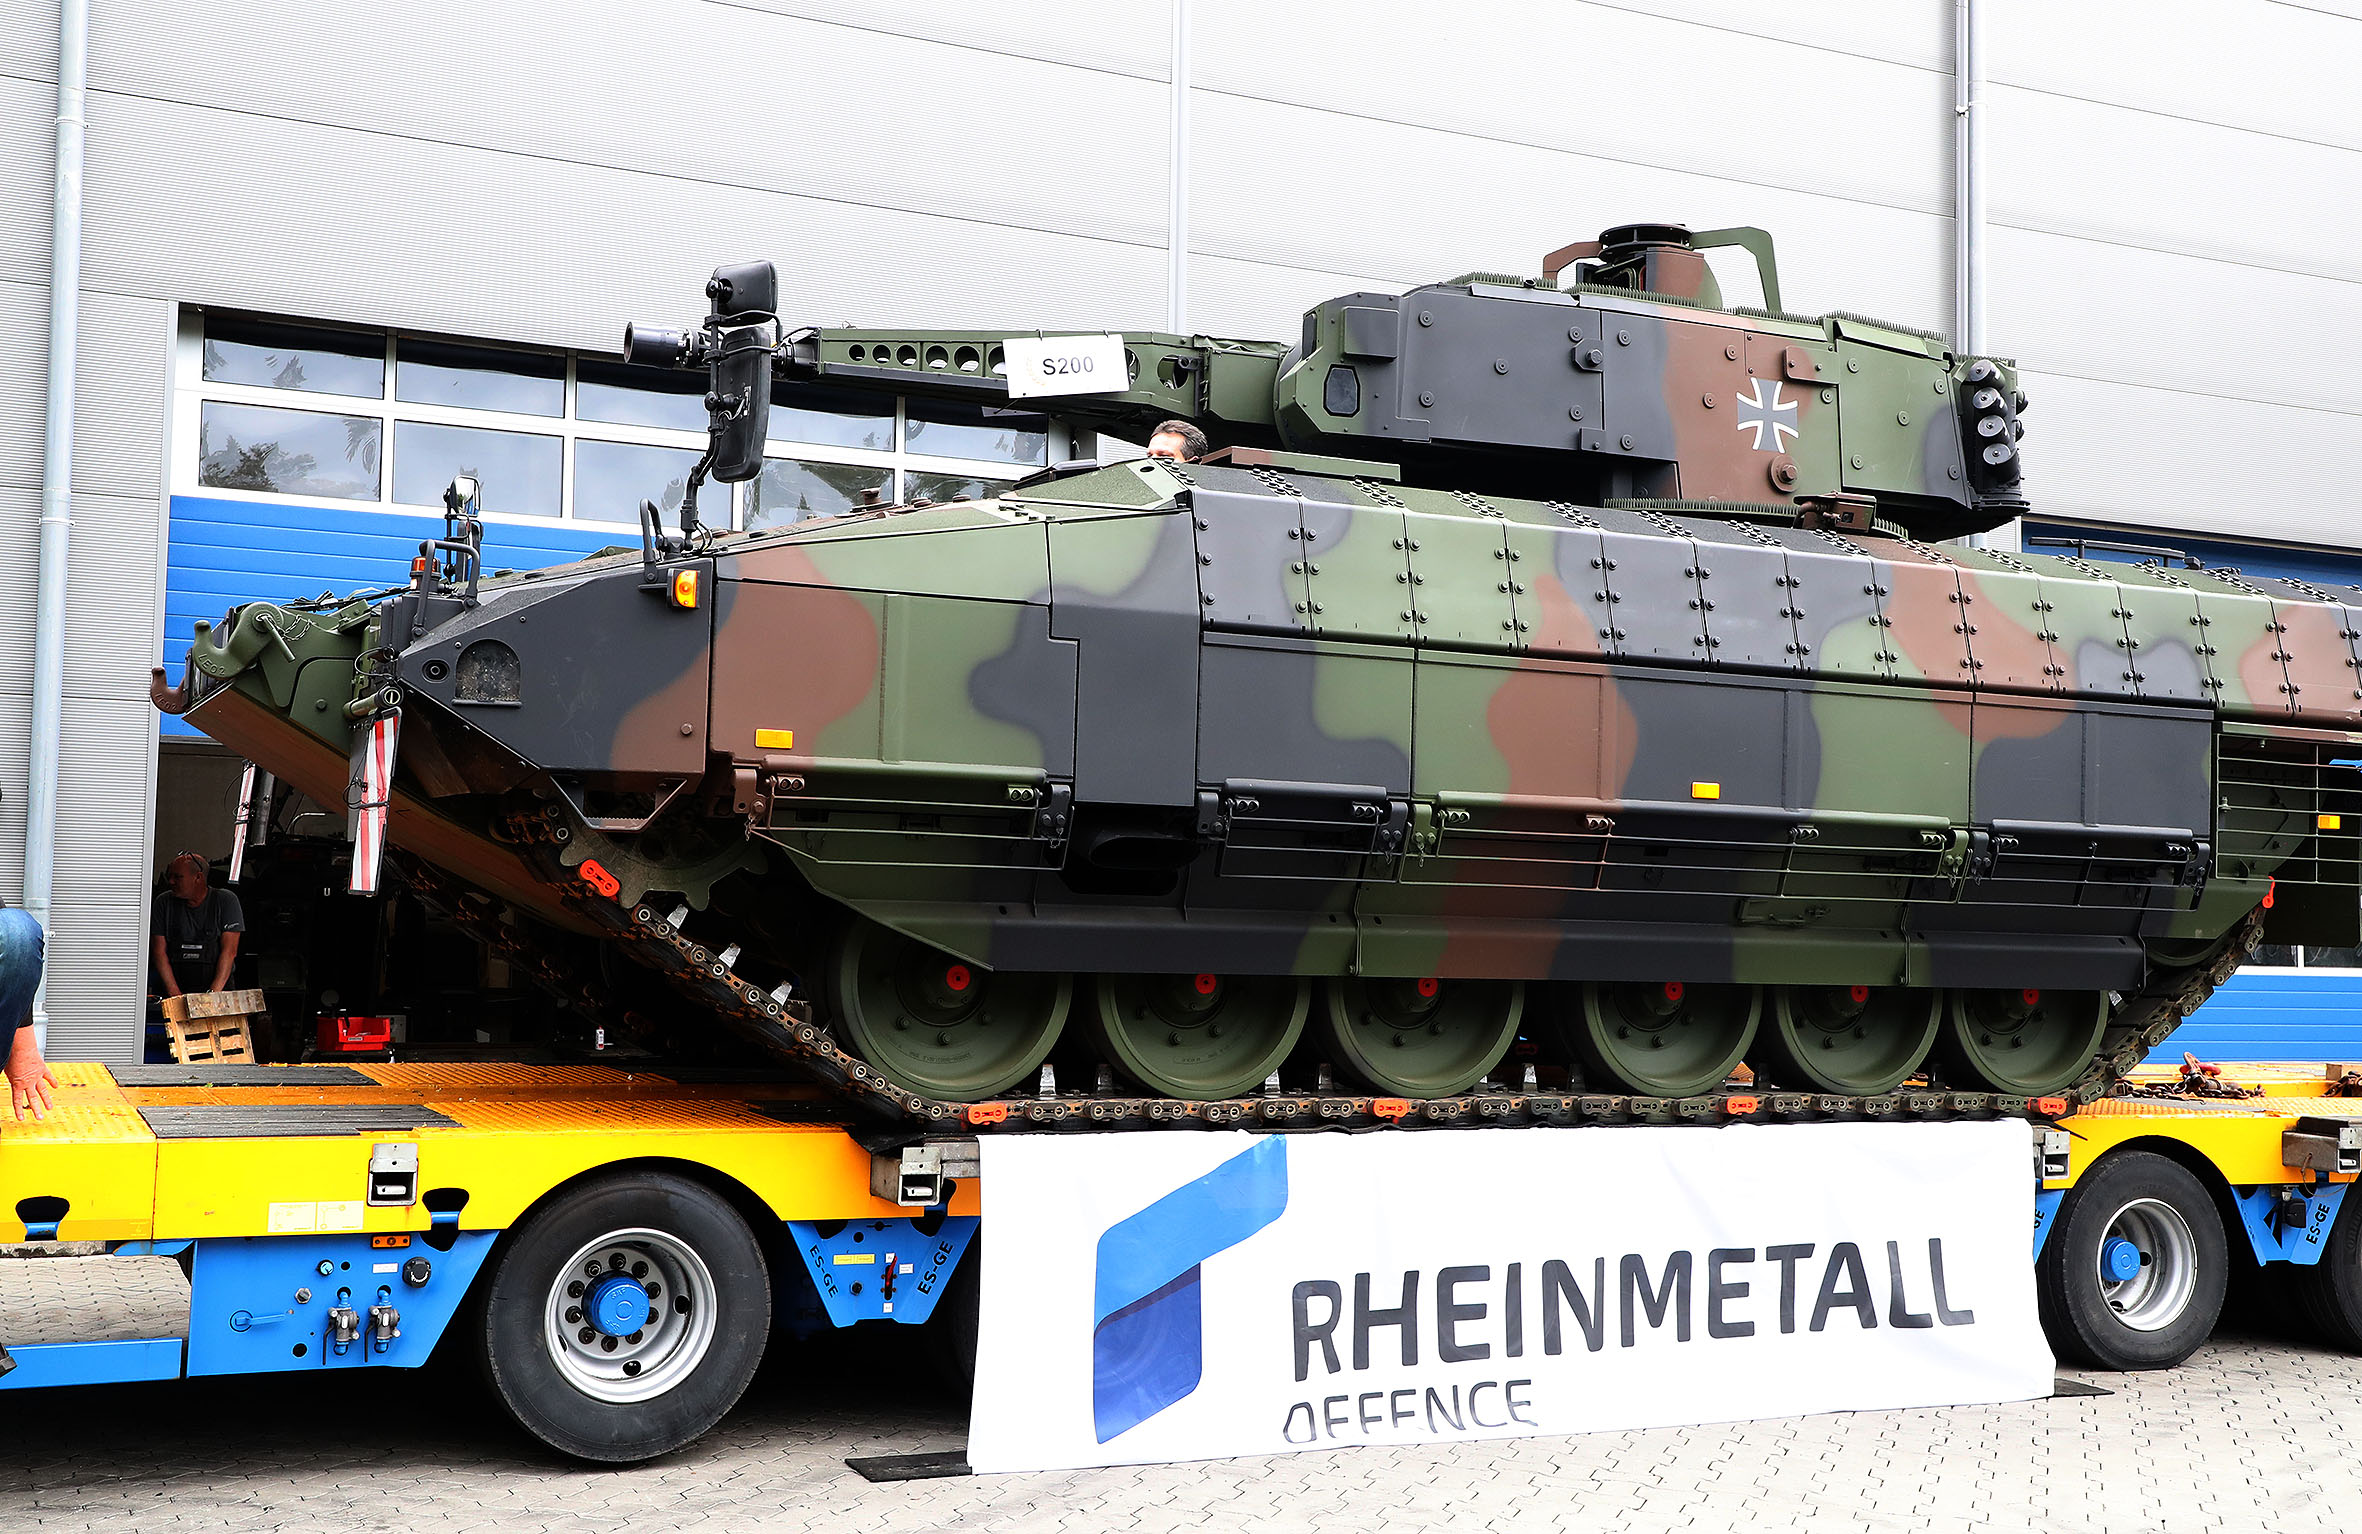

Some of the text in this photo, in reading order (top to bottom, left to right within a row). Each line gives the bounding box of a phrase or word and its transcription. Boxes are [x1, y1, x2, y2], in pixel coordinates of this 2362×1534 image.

[1042, 356, 1094, 375] S200
[2305, 1203, 2331, 1245] ES-GE
[809, 1244, 839, 1299] ES-GE
[916, 1240, 954, 1295] ES-GE
[1291, 1237, 1975, 1383] RHEINMETALL
